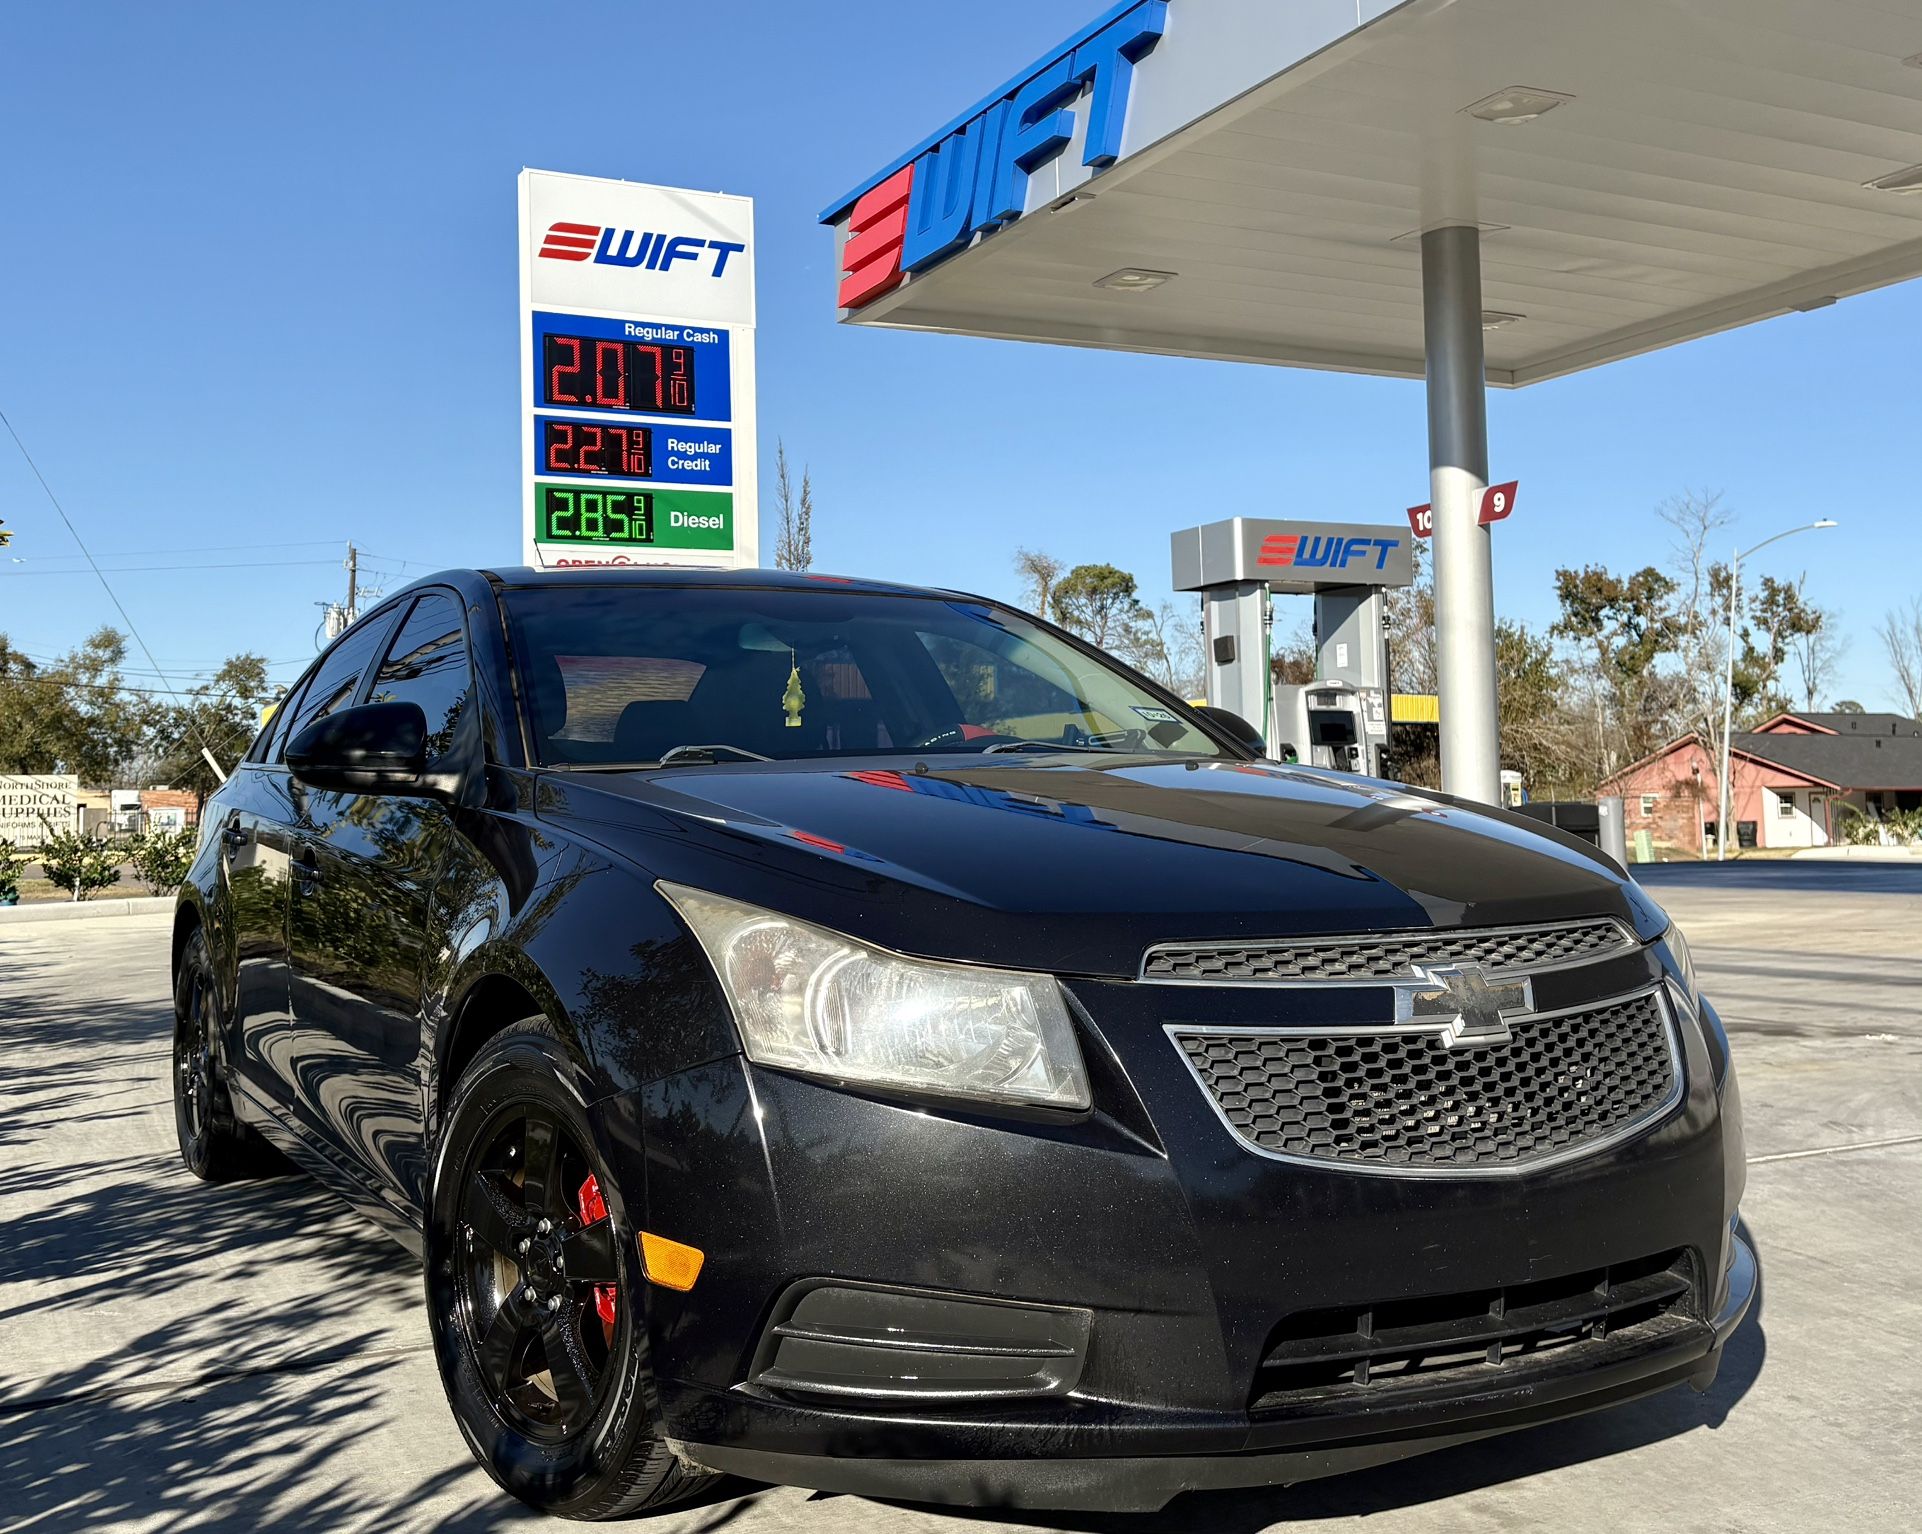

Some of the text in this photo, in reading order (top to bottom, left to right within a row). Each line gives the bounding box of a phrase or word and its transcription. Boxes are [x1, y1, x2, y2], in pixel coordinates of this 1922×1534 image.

[625, 323, 719, 344] Regular Cash
[667, 438, 721, 456] Regular
[667, 456, 710, 471] Credit
[1493, 492, 1506, 513] 9
[670, 511, 724, 529] Diesel
[1416, 509, 1432, 531] 10
[1, 806, 71, 818] UPPLIES
